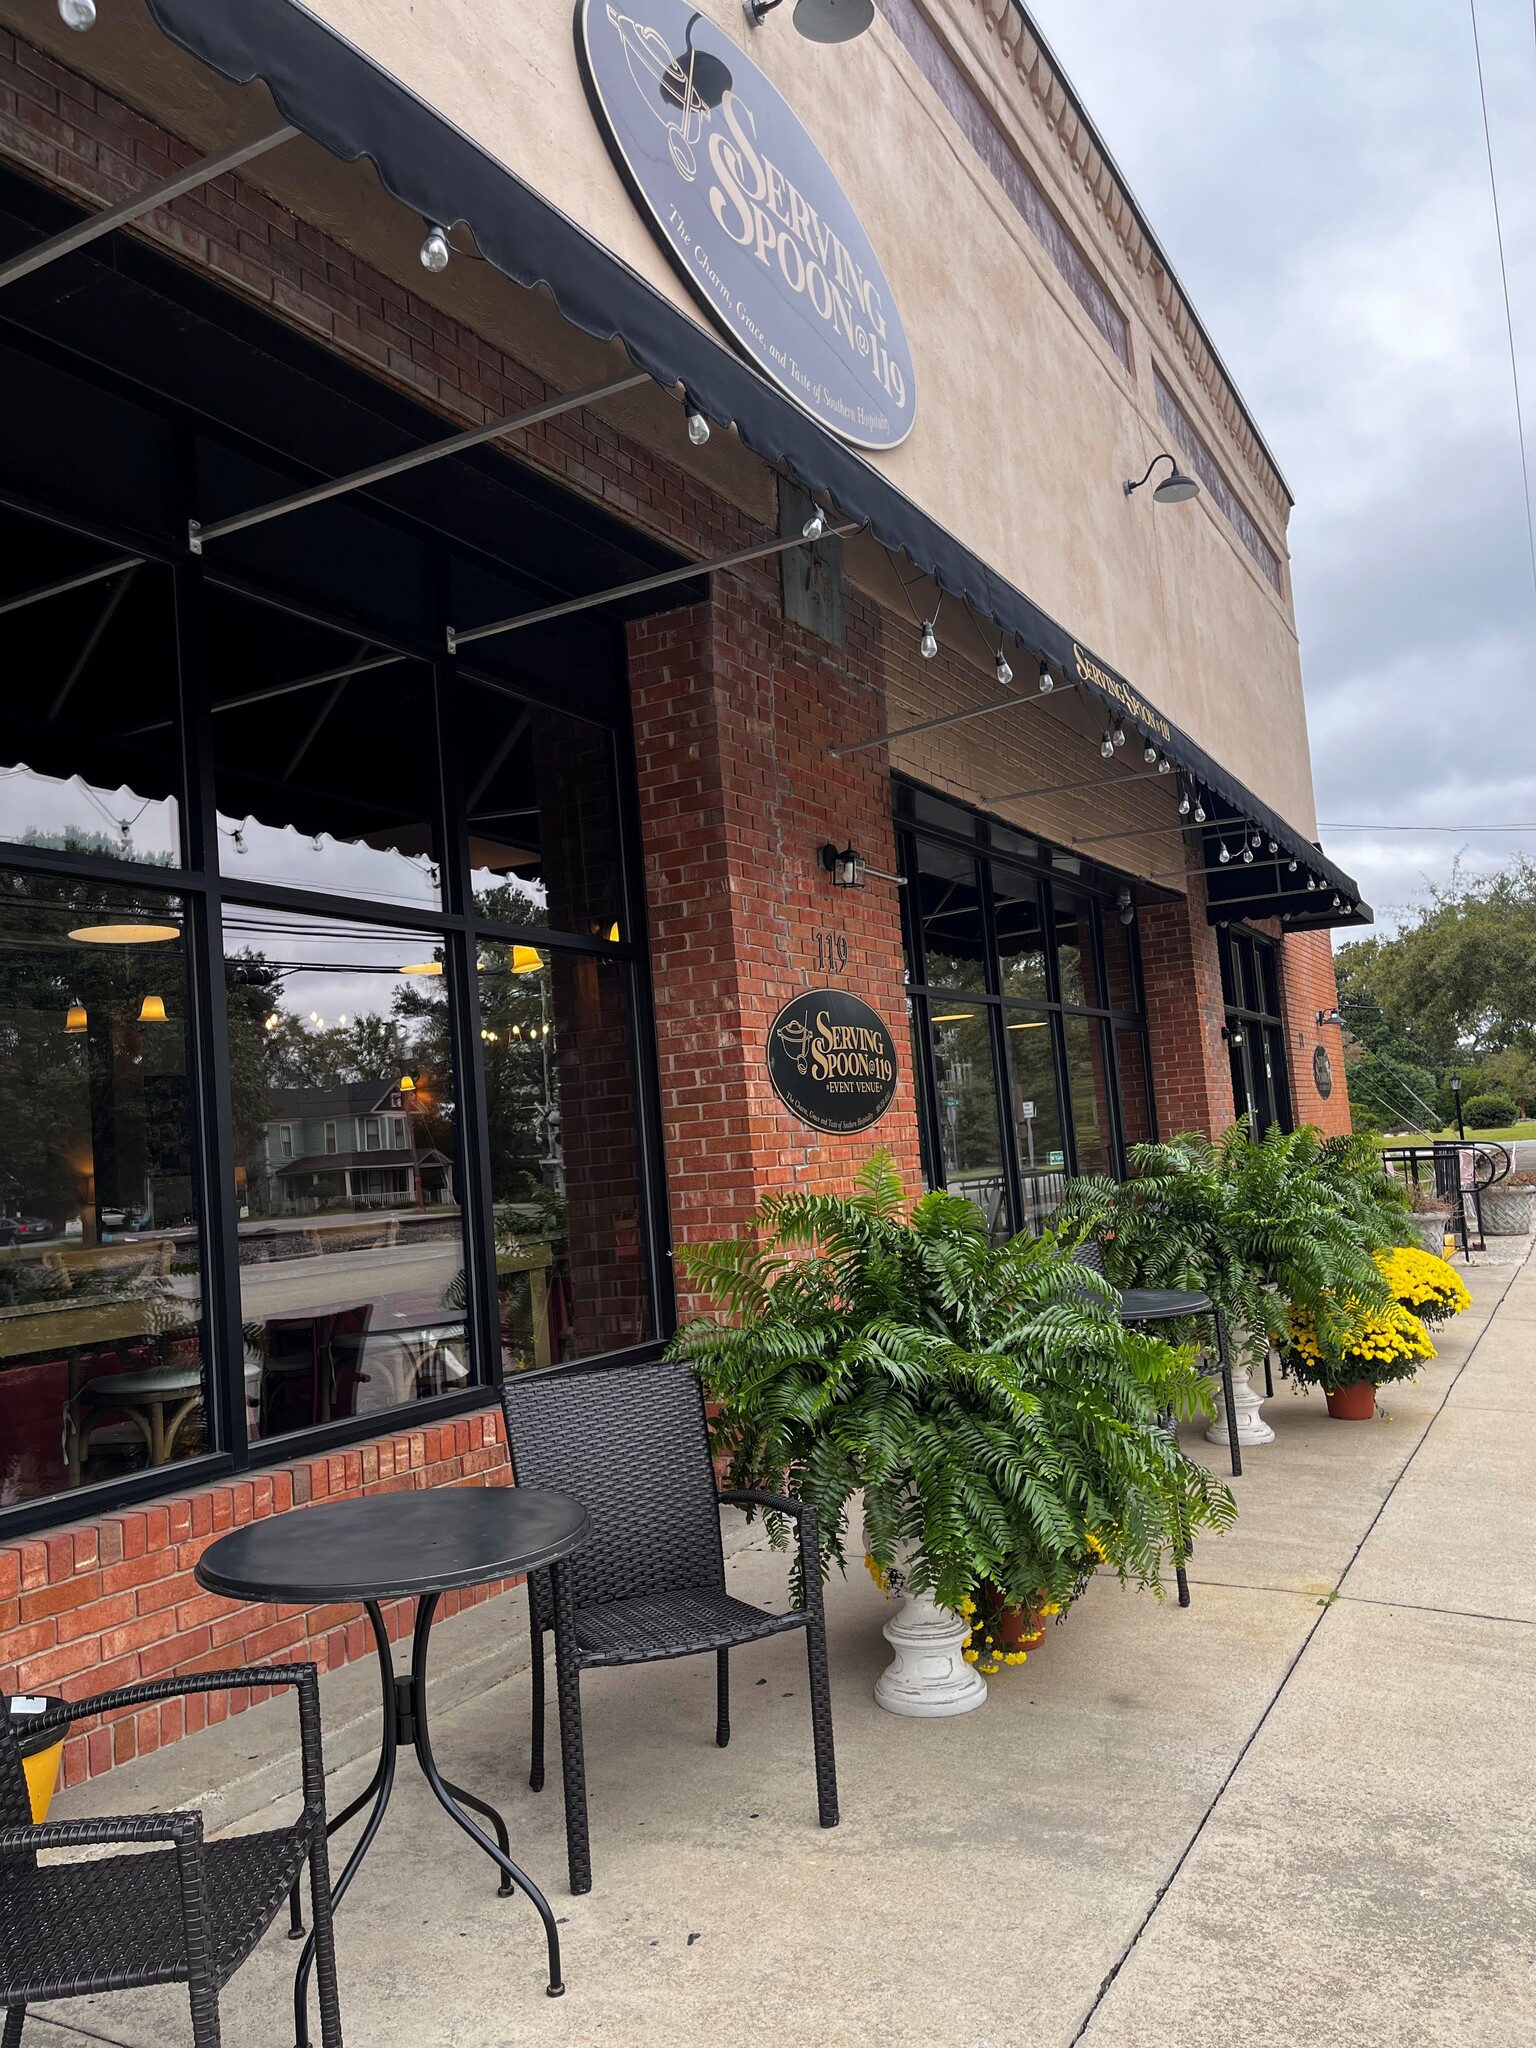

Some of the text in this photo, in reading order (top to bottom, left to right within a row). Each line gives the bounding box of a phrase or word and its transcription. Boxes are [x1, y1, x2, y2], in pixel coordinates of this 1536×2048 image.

[723, 90, 887, 342] SERVING
[668, 203, 691, 246] The
[694, 245, 732, 309] Charm,
[736, 301, 767, 351] Grace,
[769, 344, 787, 369] and
[789, 357, 811, 392] Taste
[813, 383, 822, 404] of
[823, 387, 856, 422] Southern
[1073, 643, 1126, 704] SERVING
[815, 931, 849, 973] 119
[816, 1010, 884, 1056] SERVING
[811, 1037, 893, 1081] SPOON@119
[828, 1081, 881, 1093] EVENT VENUE
